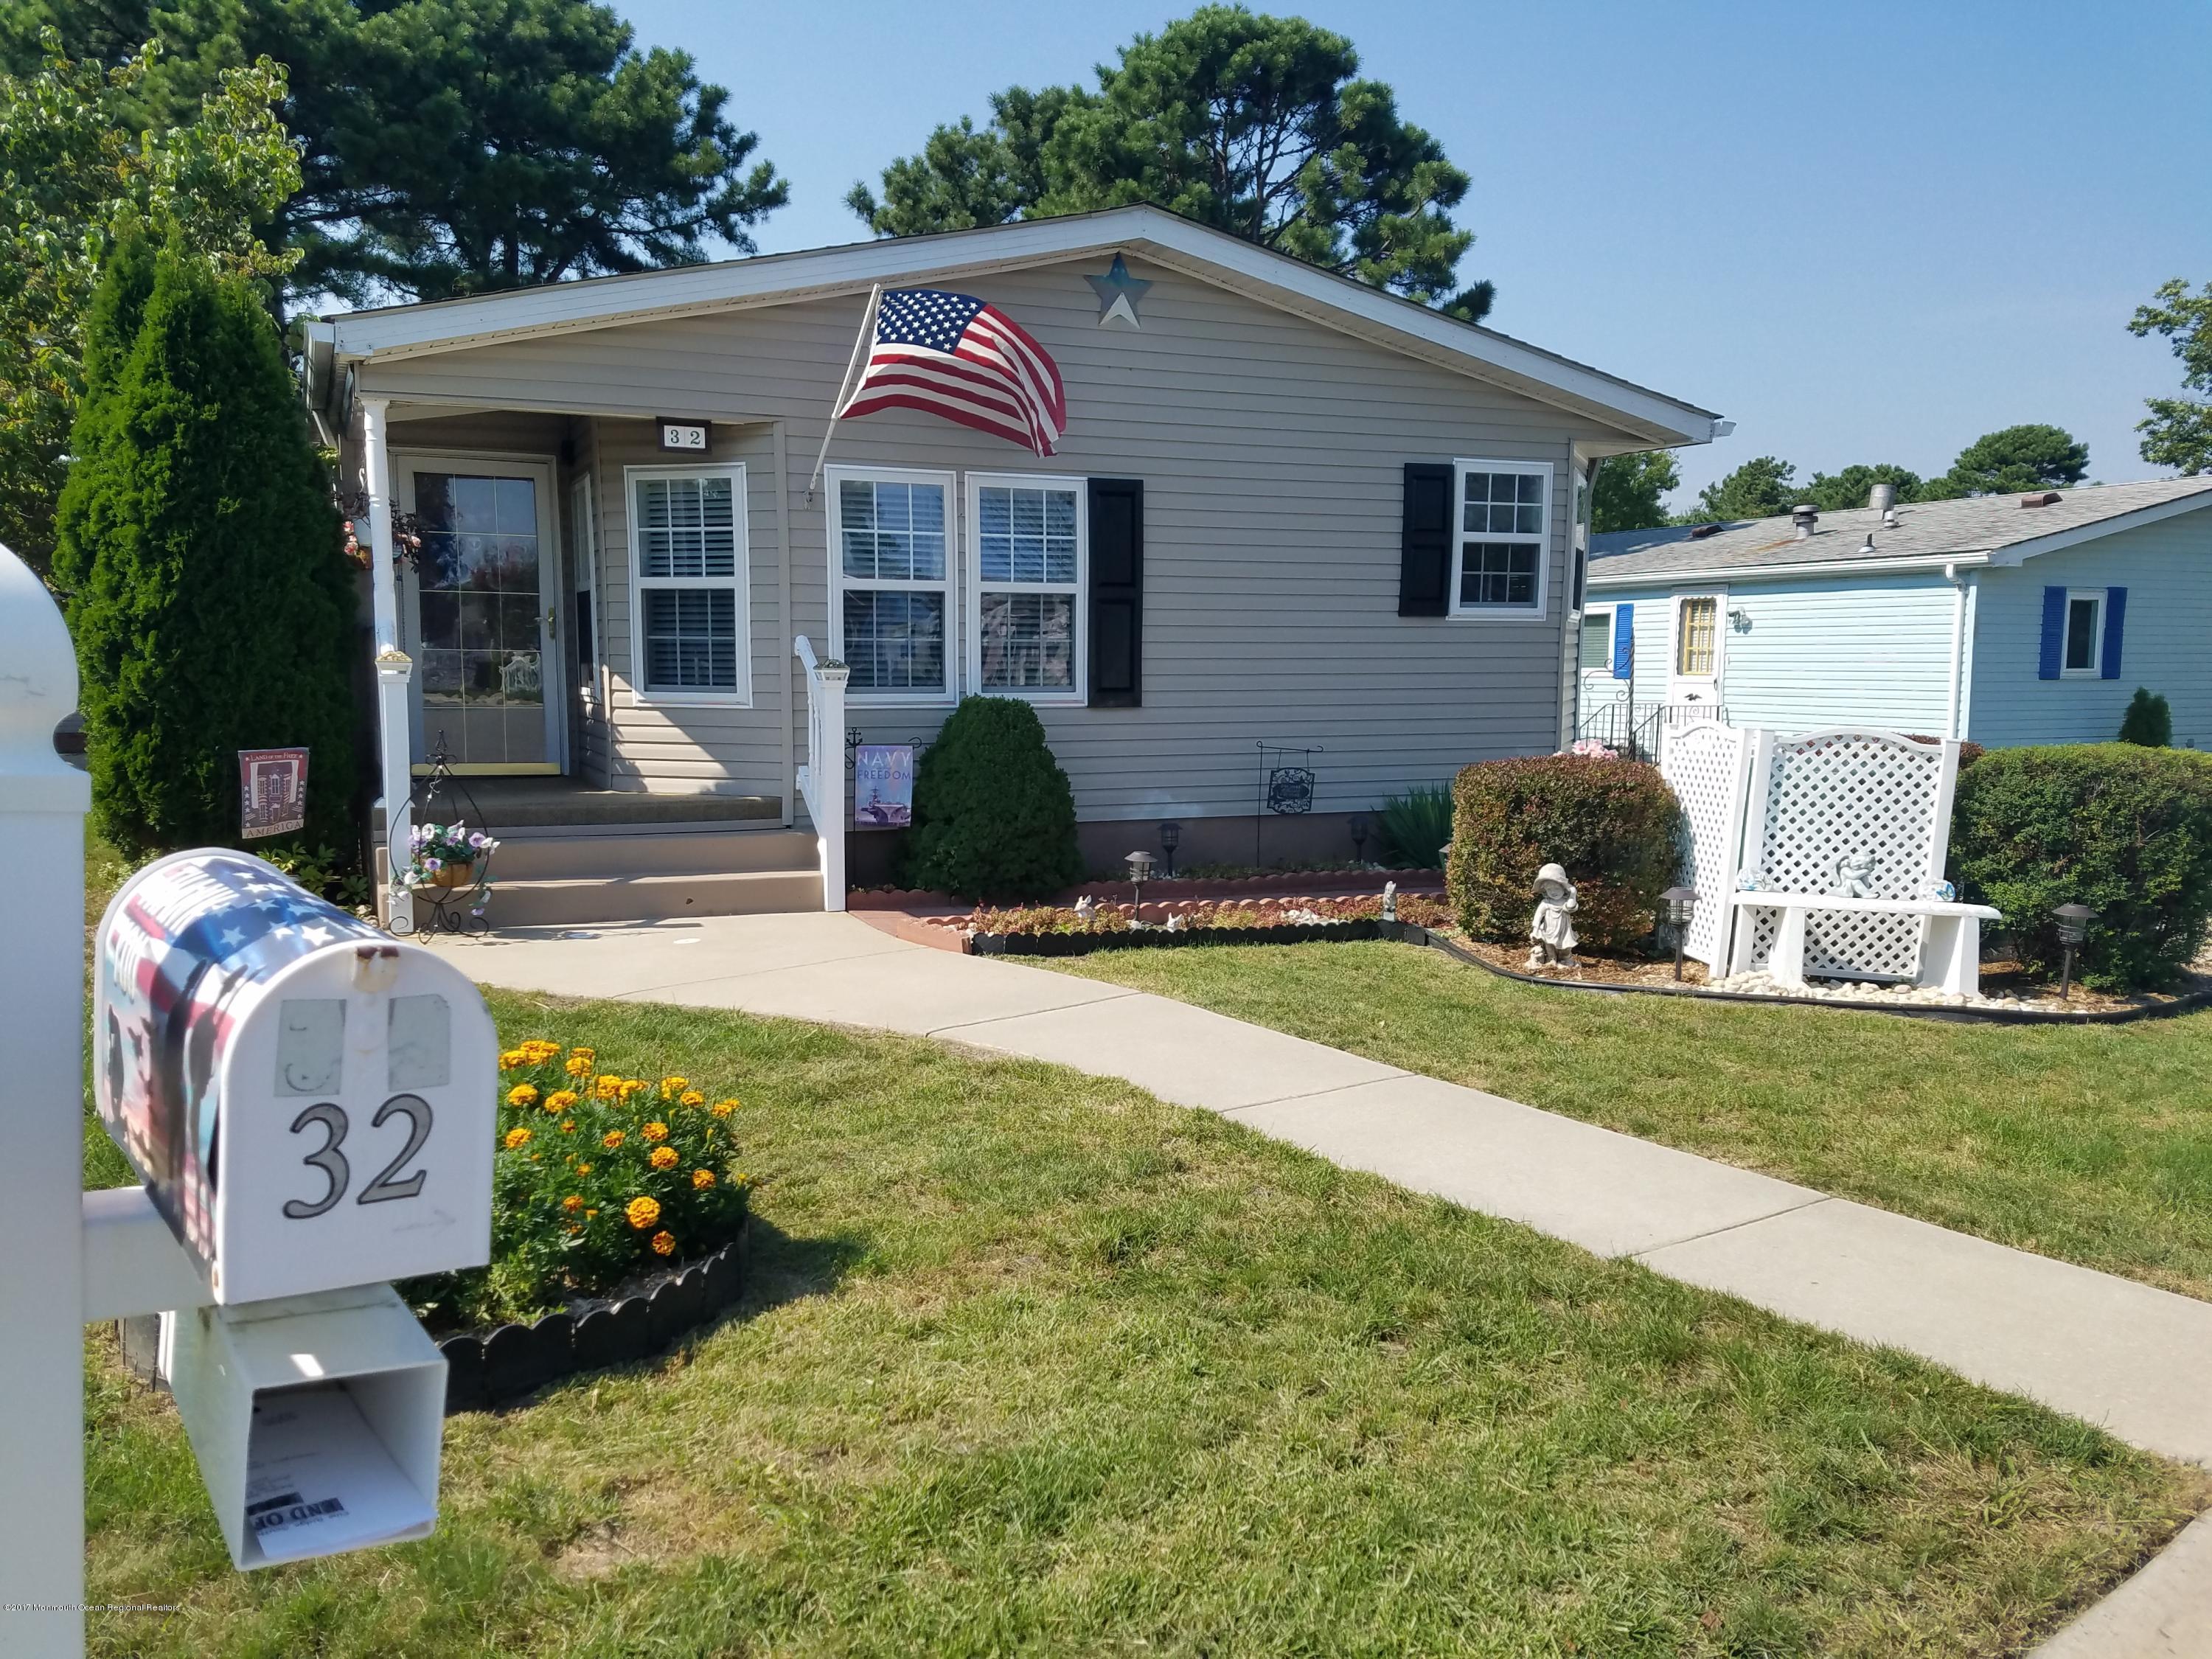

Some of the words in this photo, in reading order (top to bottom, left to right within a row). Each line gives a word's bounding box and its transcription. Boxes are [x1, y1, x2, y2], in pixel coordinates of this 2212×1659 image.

[670, 429, 701, 445] 32
[857, 751, 911, 767] NAVY
[857, 770, 911, 780] FREEDOM
[246, 820, 302, 838] AMERICA
[282, 1093, 434, 1219] 32
